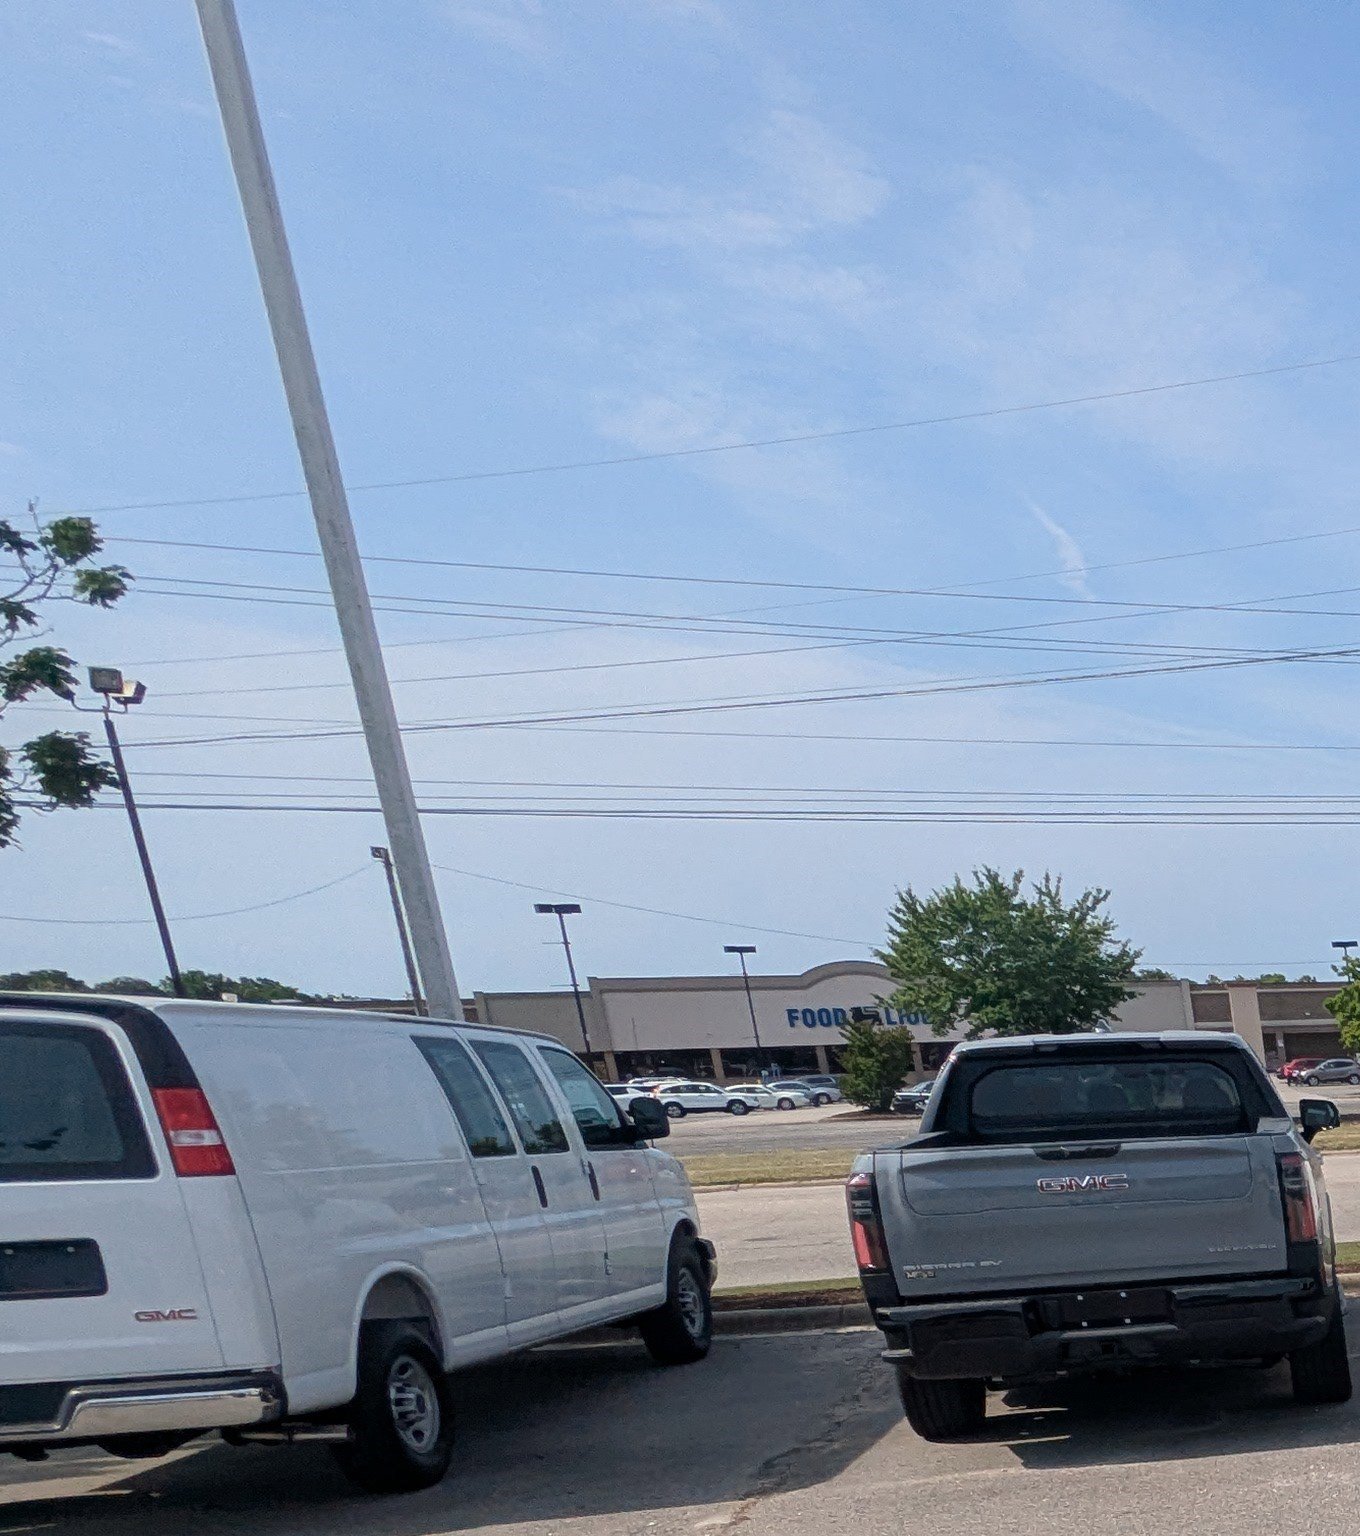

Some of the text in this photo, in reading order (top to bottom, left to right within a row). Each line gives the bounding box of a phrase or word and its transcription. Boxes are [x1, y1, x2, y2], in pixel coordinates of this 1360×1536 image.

[786, 1008, 846, 1028] FOOD
[1036, 1173, 1129, 1193] GMC
[135, 1308, 198, 1322] GMC
